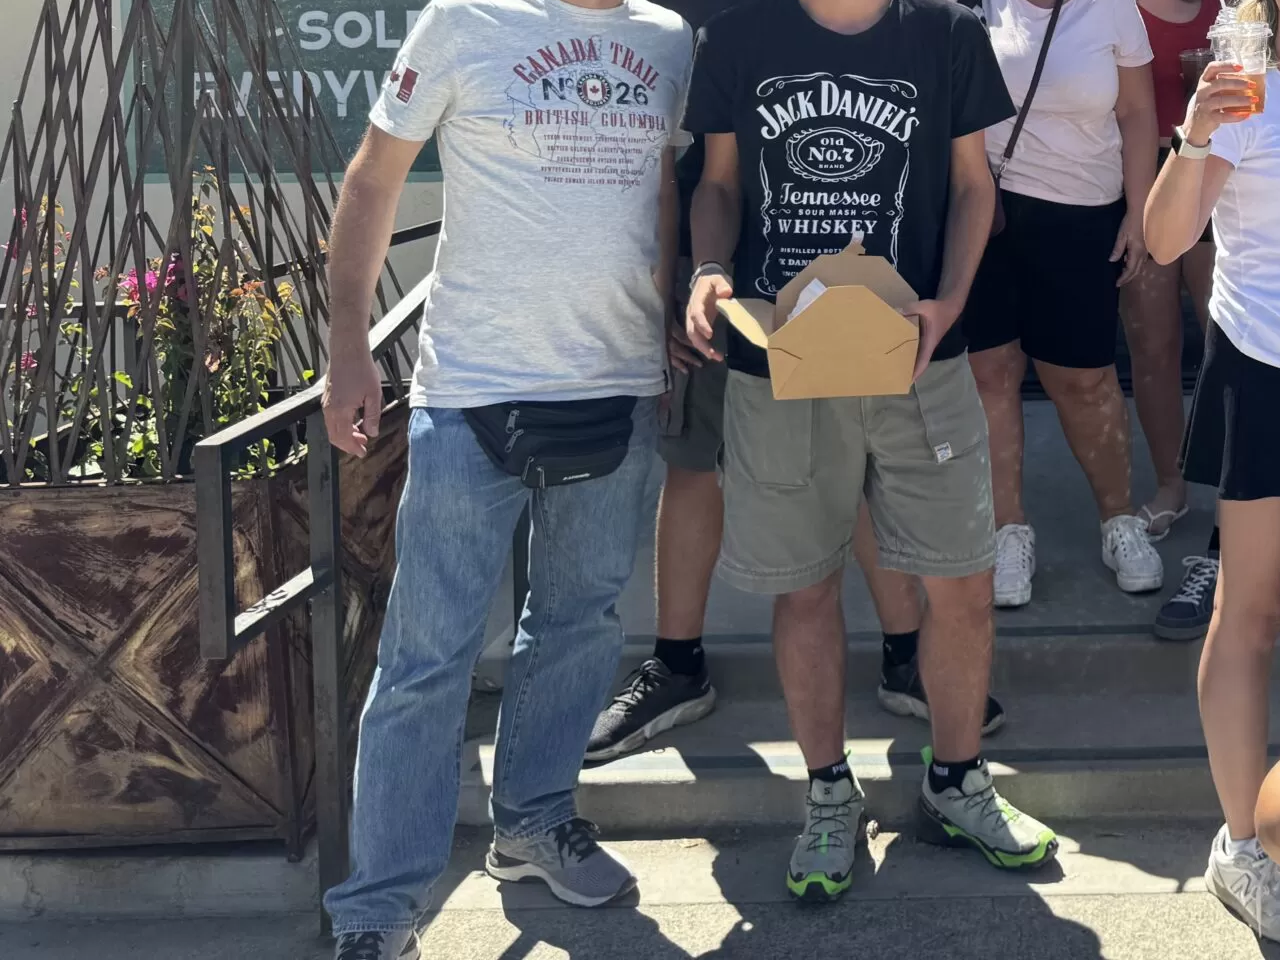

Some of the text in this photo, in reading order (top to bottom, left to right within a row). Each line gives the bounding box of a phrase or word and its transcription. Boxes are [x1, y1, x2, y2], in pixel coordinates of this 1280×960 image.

[513, 36, 660, 91] CANADA TRAIL
[615, 81, 649, 106] 26
[525, 109, 667, 132] BRITISH COLUMBIA
[756, 80, 920, 142] JACK DANIEL'S
[820, 137, 844, 146] Old
[780, 182, 881, 207] Tennessee
[798, 208, 825, 216] SOUR
[778, 218, 878, 235] WHISKEY
